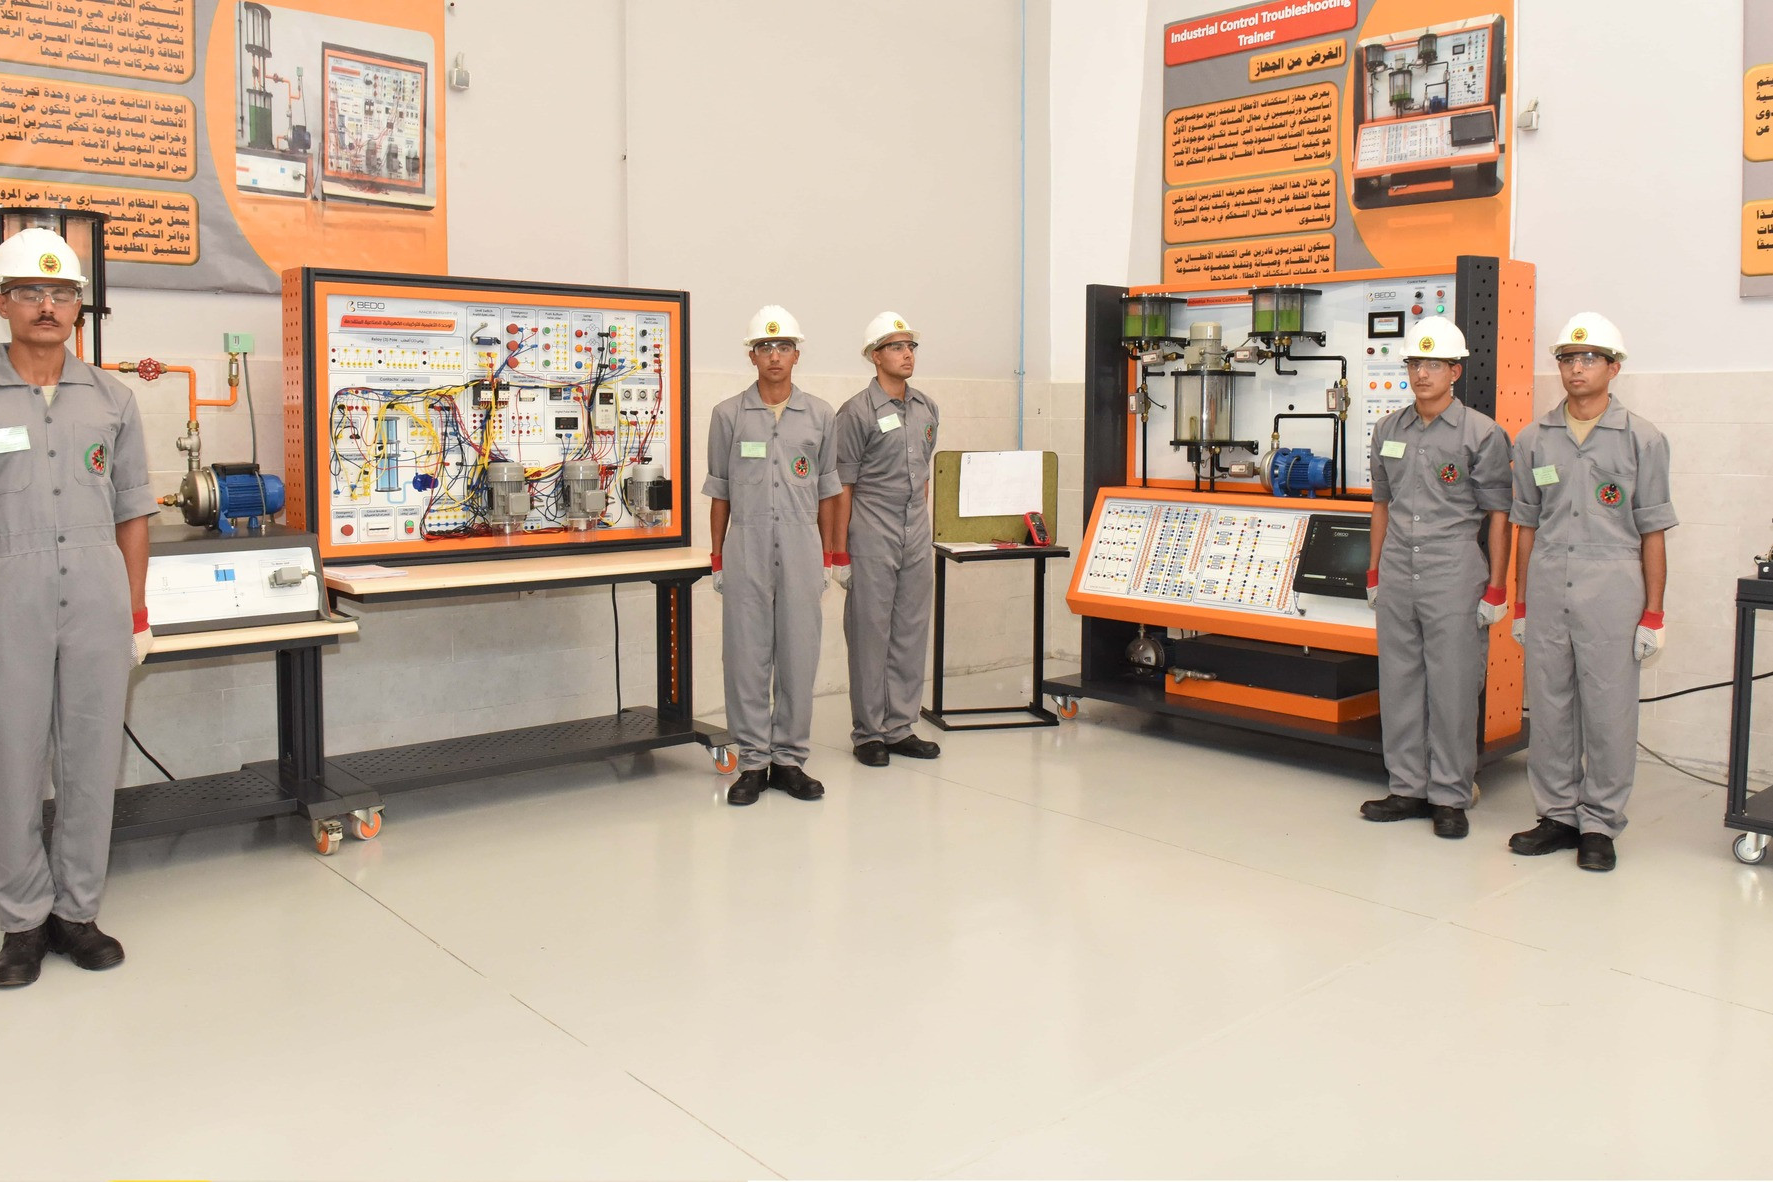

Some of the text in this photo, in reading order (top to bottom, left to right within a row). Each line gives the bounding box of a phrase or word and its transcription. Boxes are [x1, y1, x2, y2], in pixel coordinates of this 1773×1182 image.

[56, 2, 82, 17] وحدة
[26, 12, 77, 29] الصناعية
[108, 11, 132, 23] الأولى
[1171, 0, 1351, 44] Industrial Control Troubleshooting
[81, 21, 113, 34] التحكم
[117, 28, 152, 40] مكونات
[28, 29, 70, 43] العرض
[156, 33, 183, 45] تشمل
[1238, 30, 1276, 47] Trainer
[74, 36, 113, 51] وشاشات
[117, 43, 154, 57] والقياس
[158, 46, 184, 59] الطاقة
[66, 49, 185, 74] ثلاثة محركات يتم التحكم
[1254, 45, 1342, 77] الغرض من الجهاز
[1, 82, 39, 98] تجريبية
[44, 88, 70, 102] وحدة
[74, 94, 87, 103] عن
[91, 94, 116, 107] عبارة
[120, 97, 151, 110] الثانية
[1291, 94, 1306, 104] جهاز
[21, 102, 36, 112] من
[41, 104, 70, 115] تتكون
[155, 101, 186, 115] الوحدة
[101, 109, 146, 123] الصناعية
[150, 114, 186, 128] الأنظمة
[24, 118, 62, 129] كتمرين
[67, 120, 89, 133] تحكم
[92, 123, 121, 137] ولوحة
[1189, 120, 1216, 133] الموضوع
[1207, 113, 1332, 141] هو التحكم العمليات تكون
[125, 128, 146, 139] مياه
[1277, 125, 1331, 141] العملية الصناعية
[1756, 125, 1770, 136] عن
[31, 133, 73, 147] سيتمكن
[150, 131, 186, 145] وخزانين
[113, 141, 154, 154] التوصيل
[158, 147, 187, 158] كابلات
[1186, 138, 1331, 167] هو التحكم
[129, 158, 187, 174] بين الوحدات
[24, 191, 39, 201] من
[1172, 178, 1330, 204] من خلال هذا على
[76, 195, 124, 208] المعياري
[128, 198, 157, 209] النظام
[161, 200, 190, 214] يضيف
[1174, 189, 1330, 216] عملية الخلط على التحكم
[1174, 201, 1330, 226] فيها من خلال التحكم درجة الحرارة
[149, 216, 163, 225] من
[167, 216, 190, 228] يجعل
[132, 228, 190, 242] دوائر التحكم
[113, 242, 148, 253] المطلوب
[152, 243, 190, 256] للتطبيق
[1239, 242, 1330, 258] سيكون المتدربون على
[1314, 254, 1329, 264] خلال
[1203, 263, 1230, 272] مجموعة
[1374, 291, 1396, 299] BEDO
[357, 301, 385, 310] BEDO
